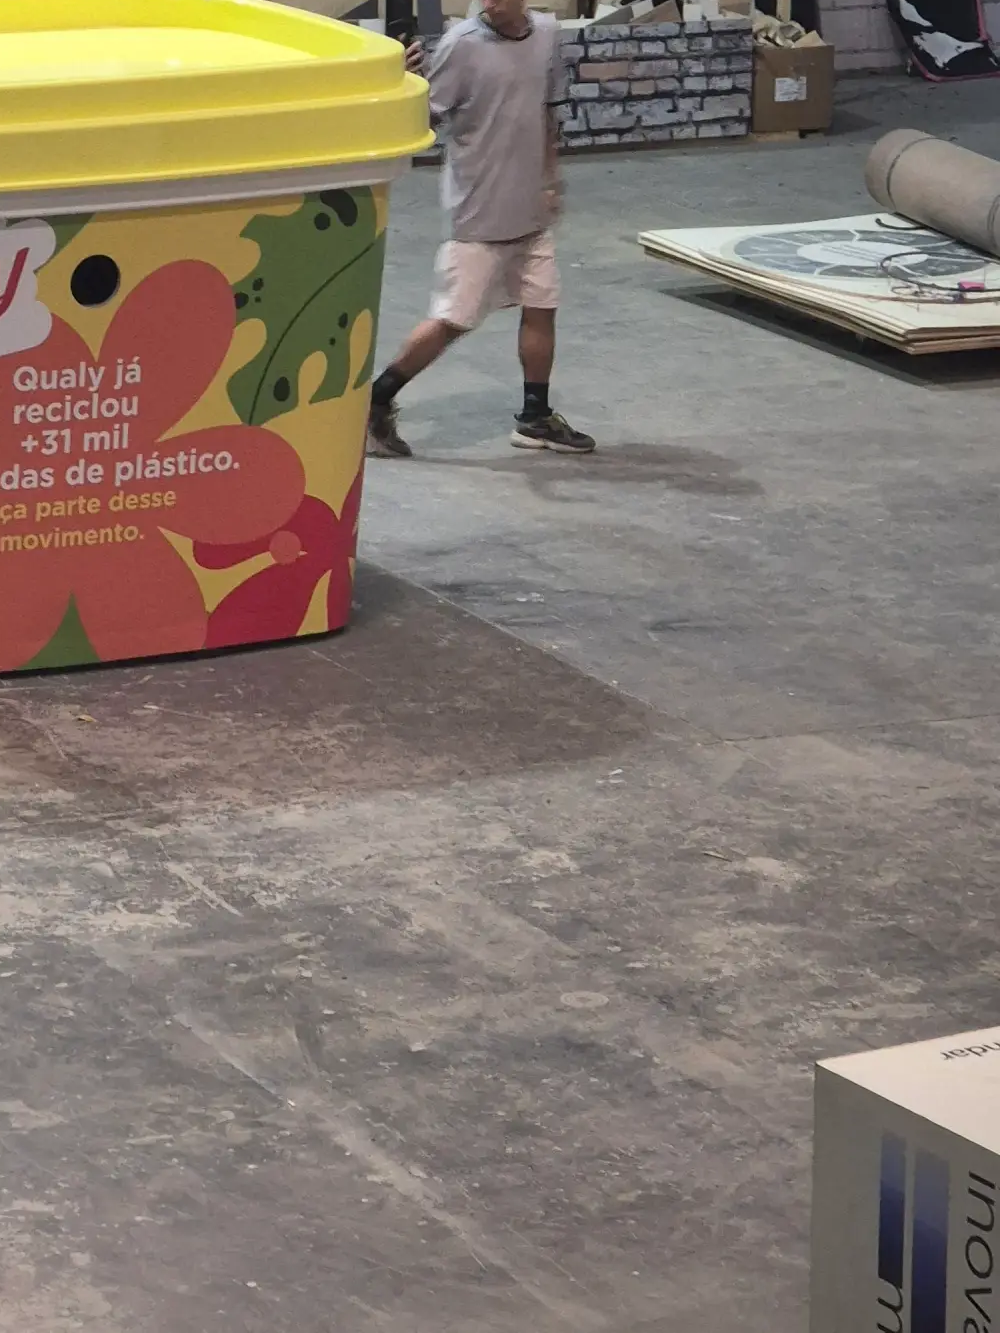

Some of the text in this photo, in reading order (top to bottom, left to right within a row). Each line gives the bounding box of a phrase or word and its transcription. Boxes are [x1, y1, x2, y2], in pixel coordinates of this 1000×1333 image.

[13, 356, 142, 392] Qualy já
[13, 393, 139, 424] reciclou
[21, 423, 130, 456] +31 mil
[65, 458, 104, 486] de
[115, 448, 240, 487] plástico.
[34, 495, 101, 522] parte
[108, 490, 177, 512] desse
[0, 523, 145, 552] movimento.
